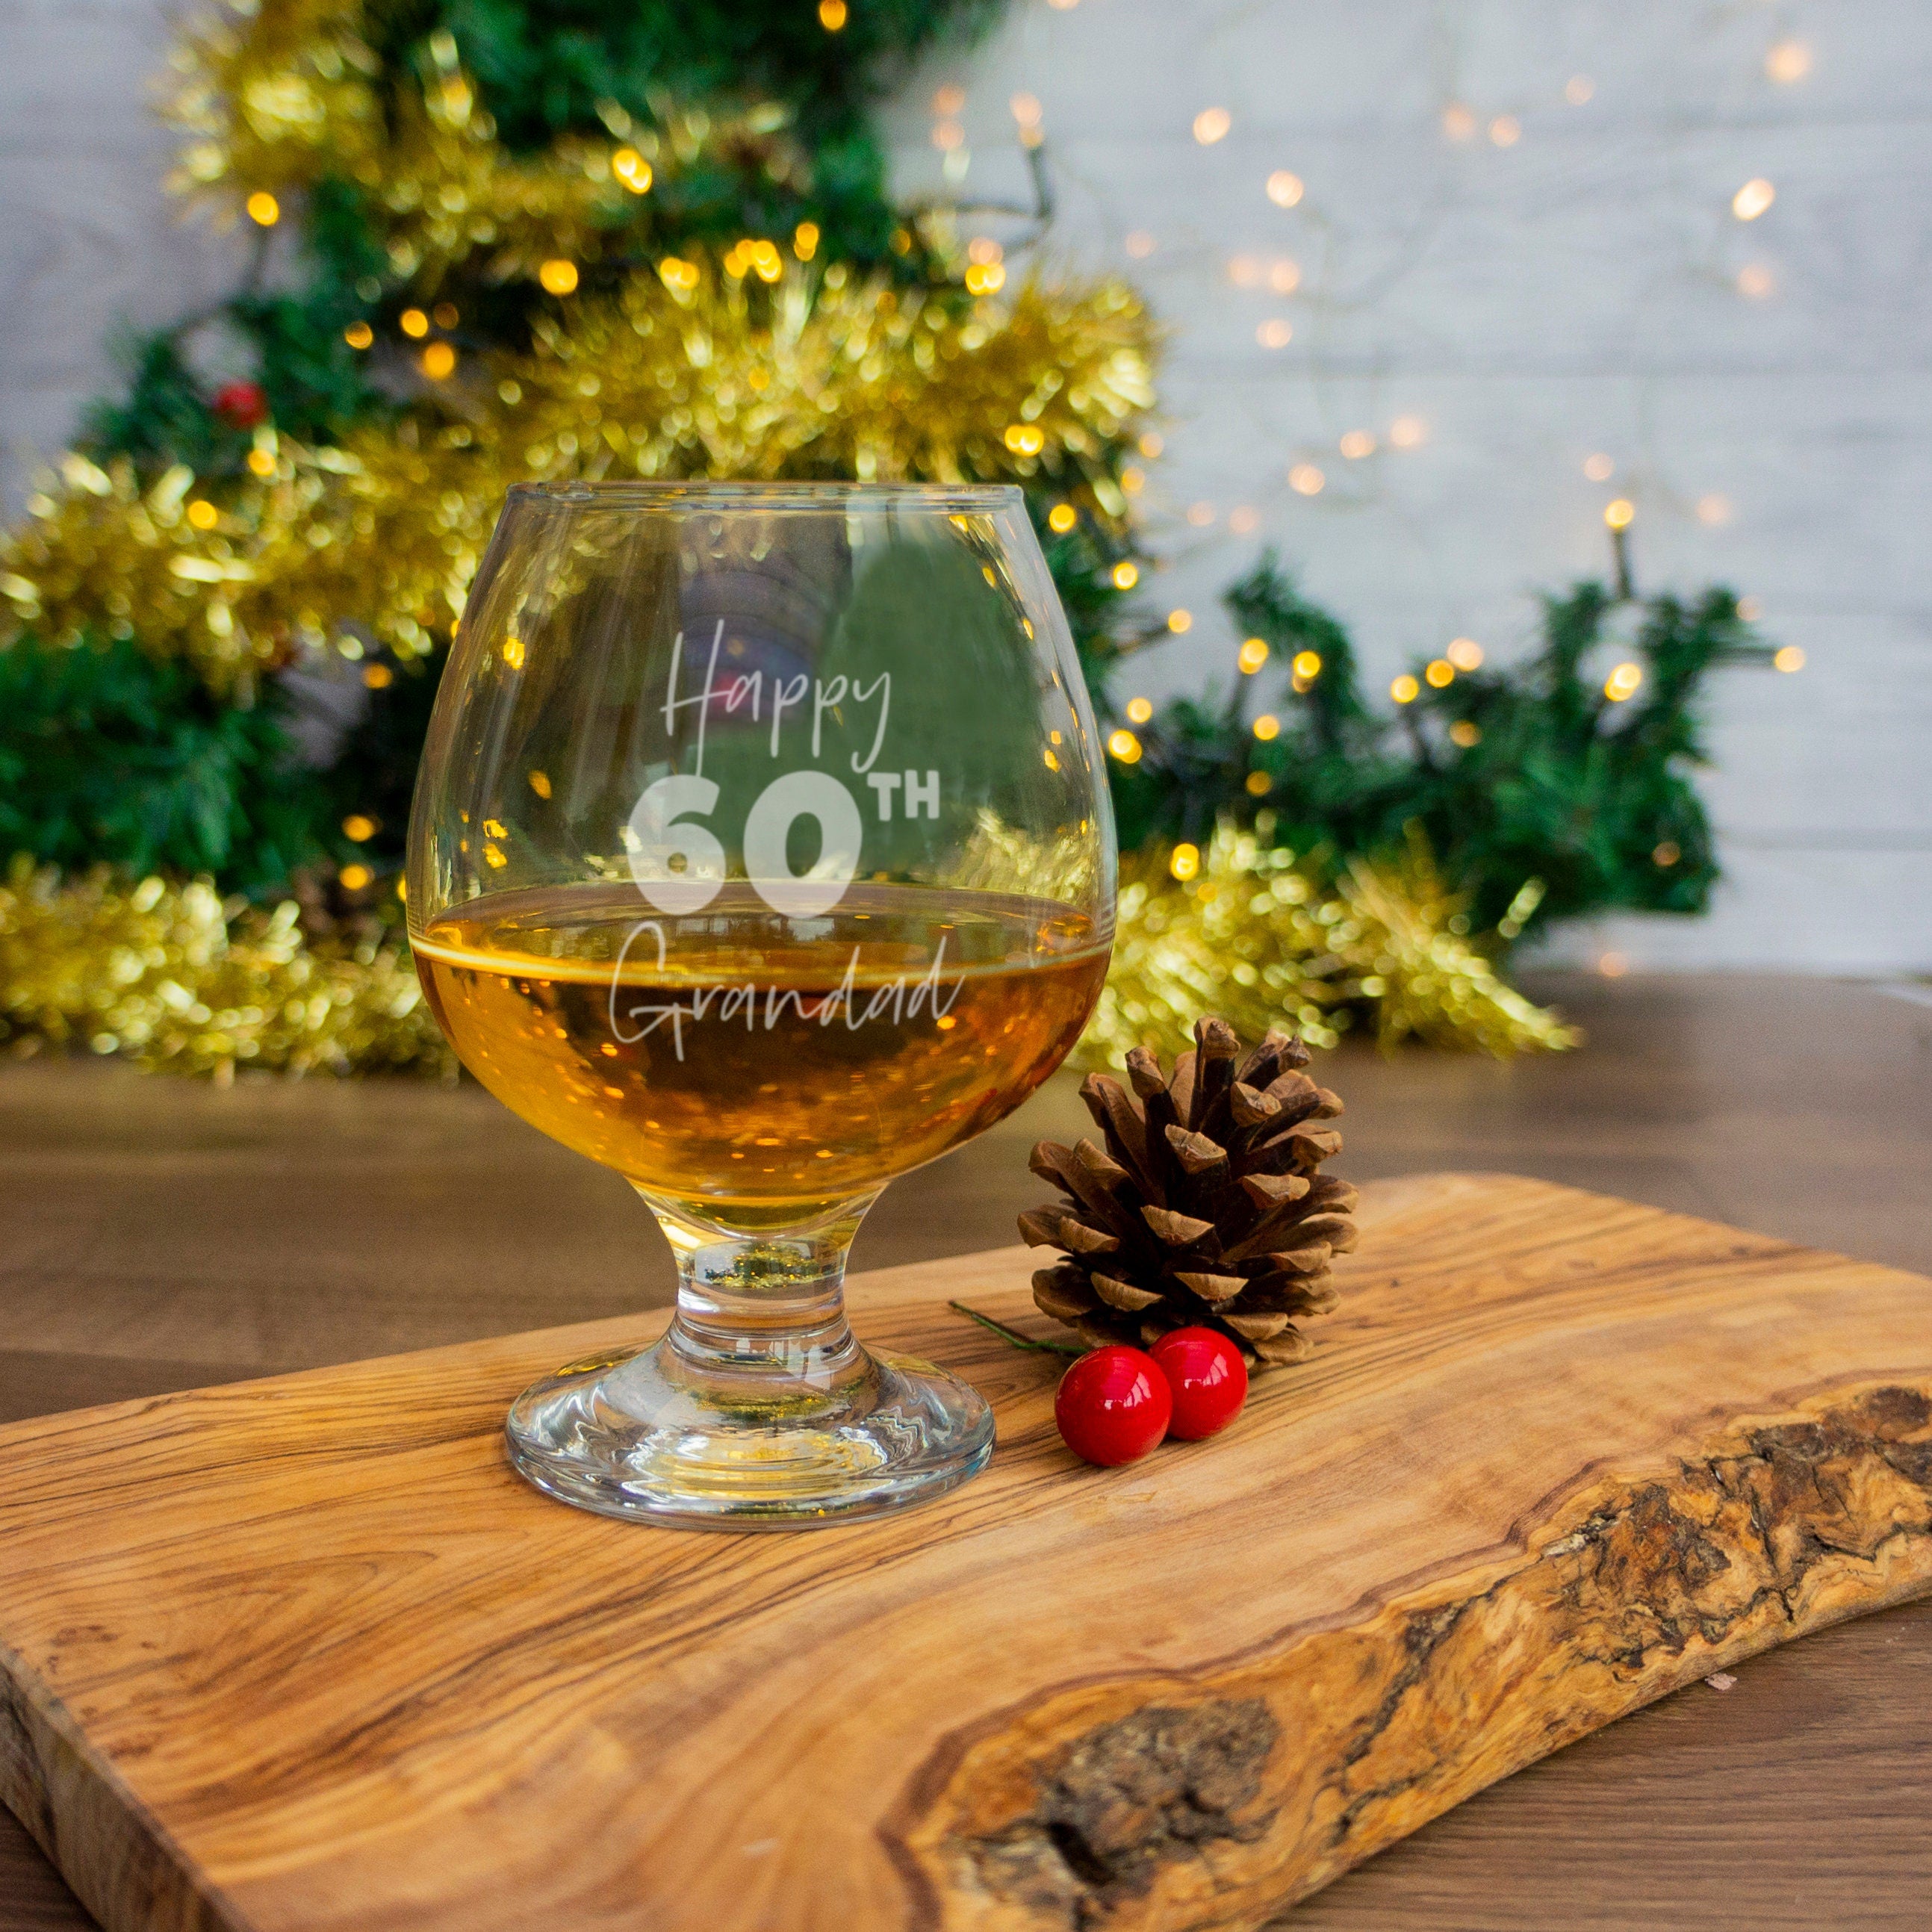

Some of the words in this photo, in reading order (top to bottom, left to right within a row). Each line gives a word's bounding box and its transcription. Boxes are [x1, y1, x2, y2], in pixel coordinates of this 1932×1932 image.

[659, 619, 891, 777] Happy
[626, 769, 940, 919] 60TH
[609, 920, 966, 1062] Grandad
